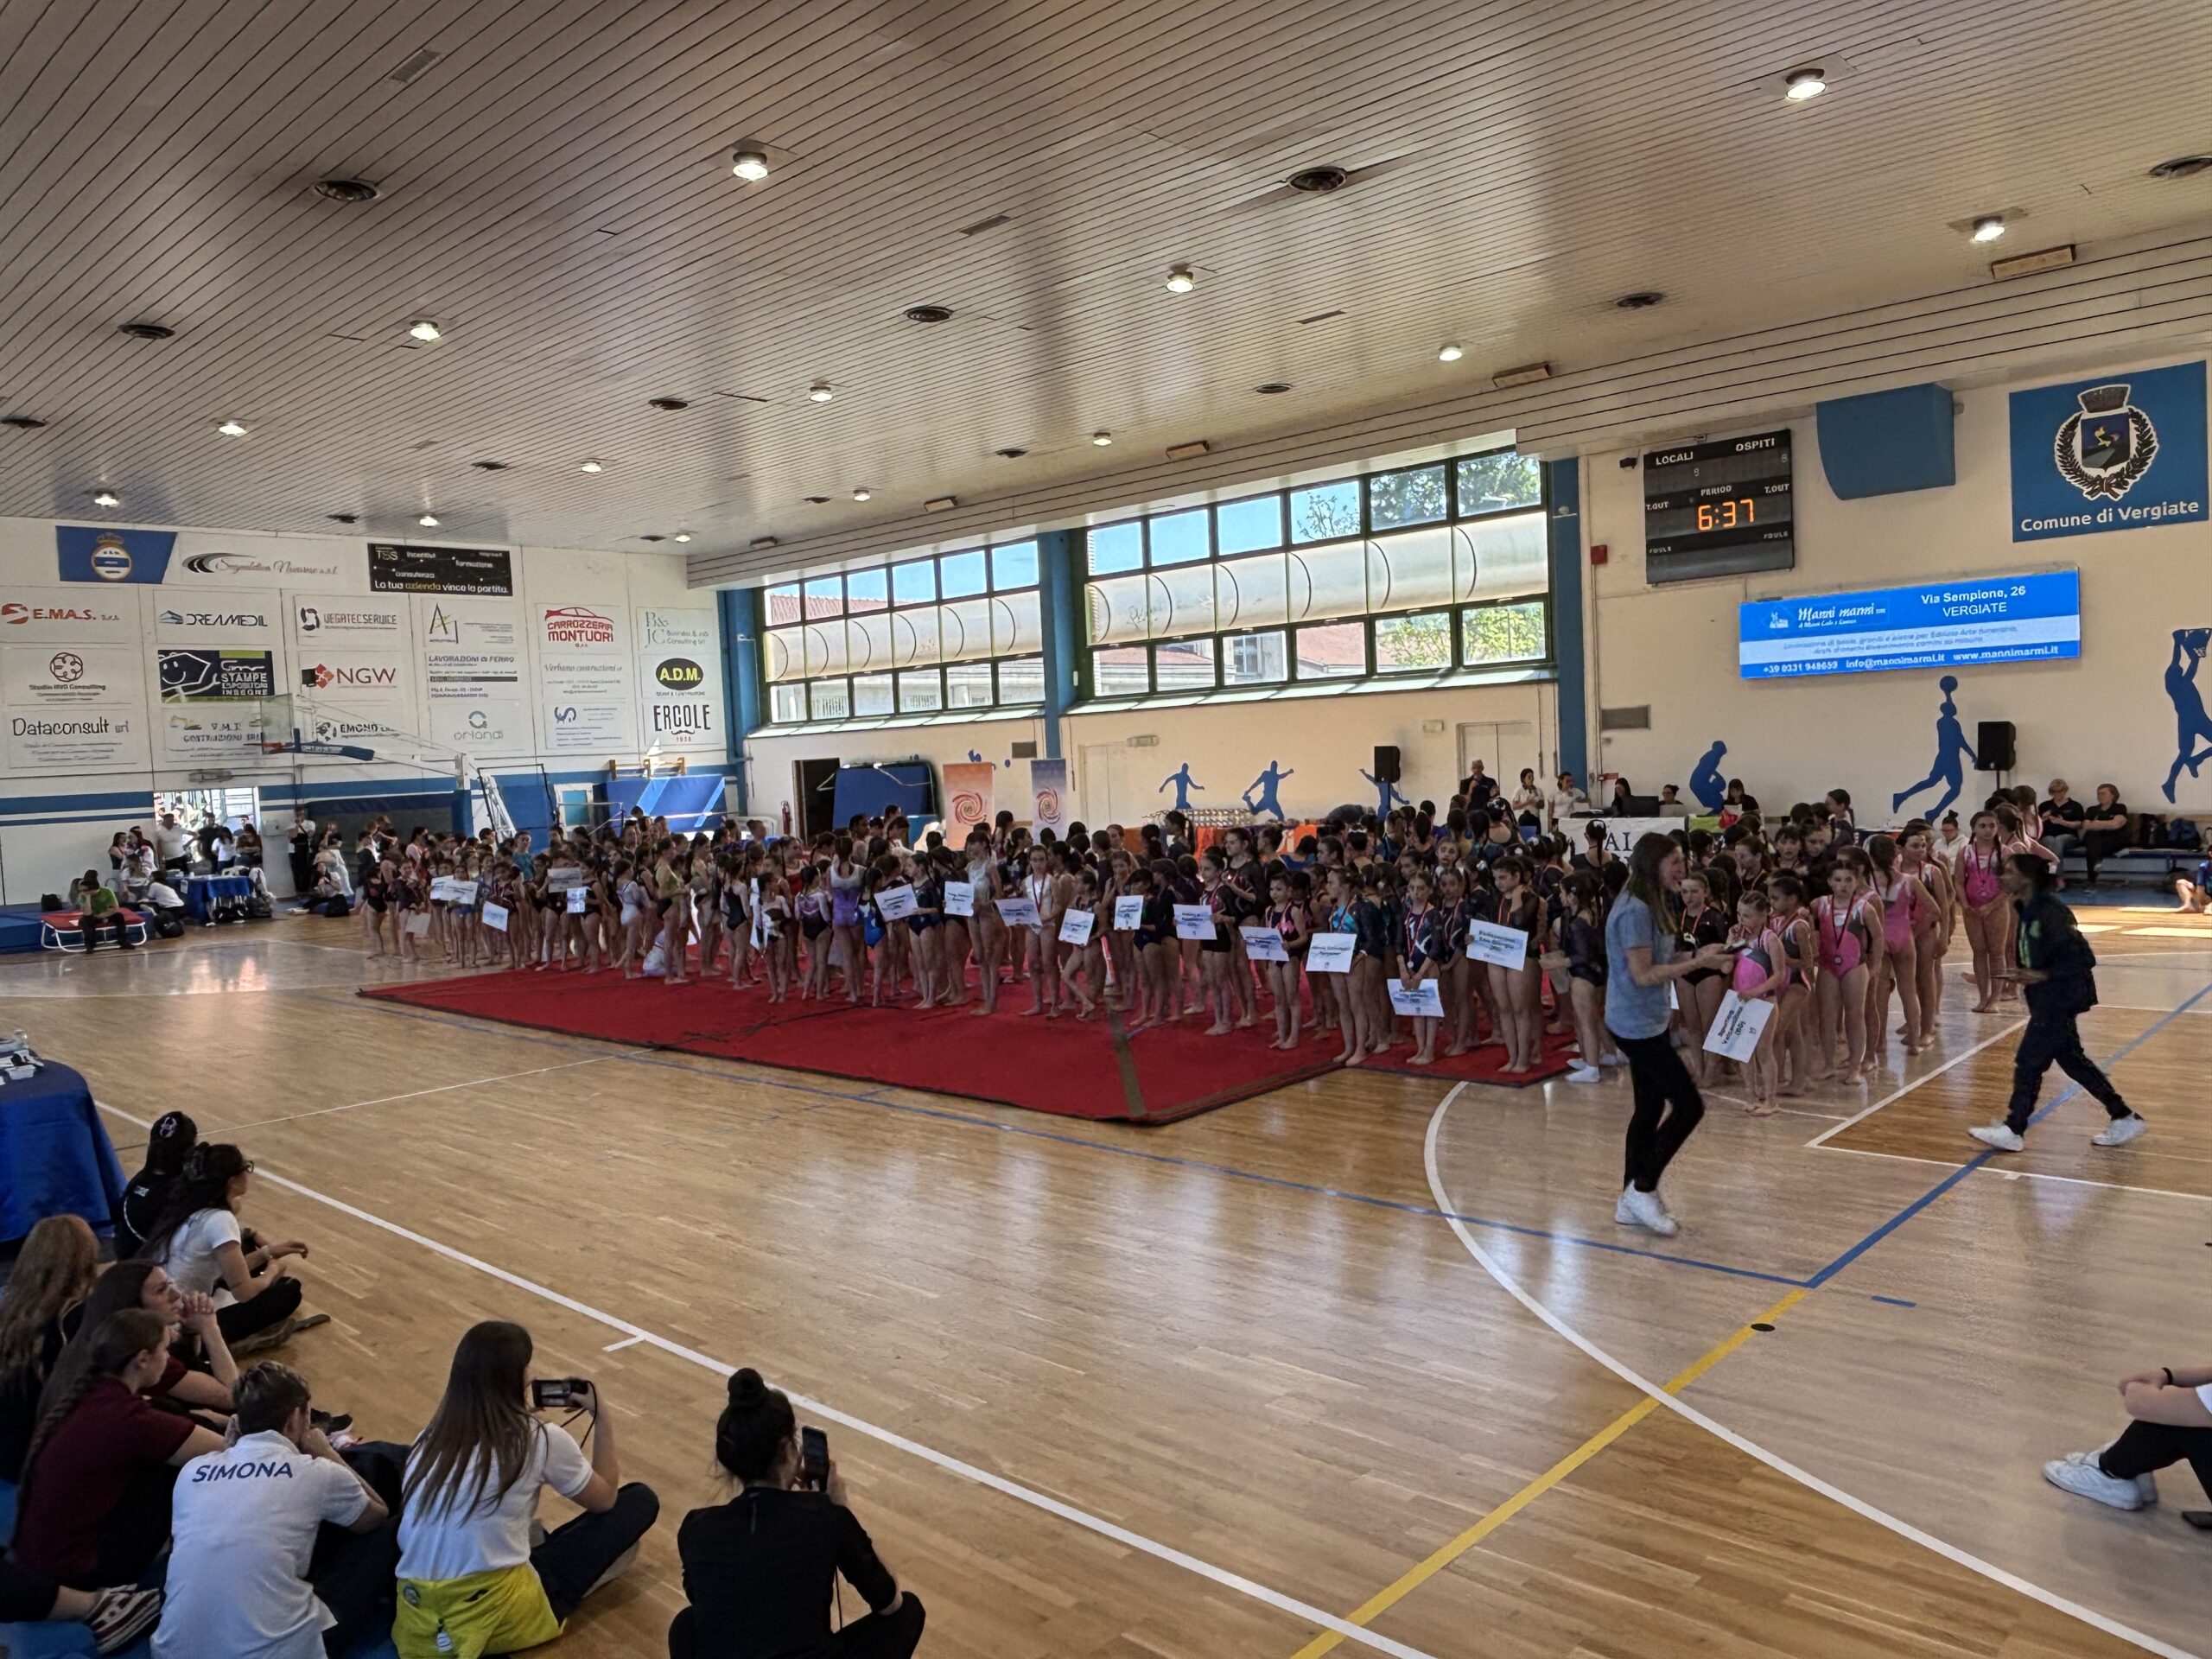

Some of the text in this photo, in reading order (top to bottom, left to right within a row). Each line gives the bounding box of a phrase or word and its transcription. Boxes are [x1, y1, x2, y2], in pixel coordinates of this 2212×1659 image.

[1735, 437, 1775, 452] OSPITI
[1656, 451, 1694, 466] LOCALI
[1764, 483, 1790, 493] T.OUT
[1646, 501, 1669, 511] T.OUT
[1697, 498, 1755, 531] 6:37
[2020, 500, 2199, 532] Comune di Vergiate
[376, 550, 398, 561] TSS
[375, 580, 386, 589] La
[387, 581, 404, 589] tua
[405, 582, 442, 591] azienda
[442, 582, 467, 592] vince
[467, 583, 476, 592] la
[1921, 585, 2026, 604] Via Sempione, 26
[1942, 602, 2007, 618] VERGIATE
[186, 613, 269, 627] DREAMEDIL
[547, 620, 613, 632] CARROZZERIA
[548, 630, 614, 642] MONTUORI
[659, 667, 702, 681] A.D.M.
[1781, 662, 1803, 672] 0331
[221, 672, 268, 683] STAMPE
[336, 667, 397, 684] NGW
[653, 704, 711, 732] ERCOLE
[12, 716, 110, 736] Dataconsult
[192, 1462, 294, 1483] SIMONA
